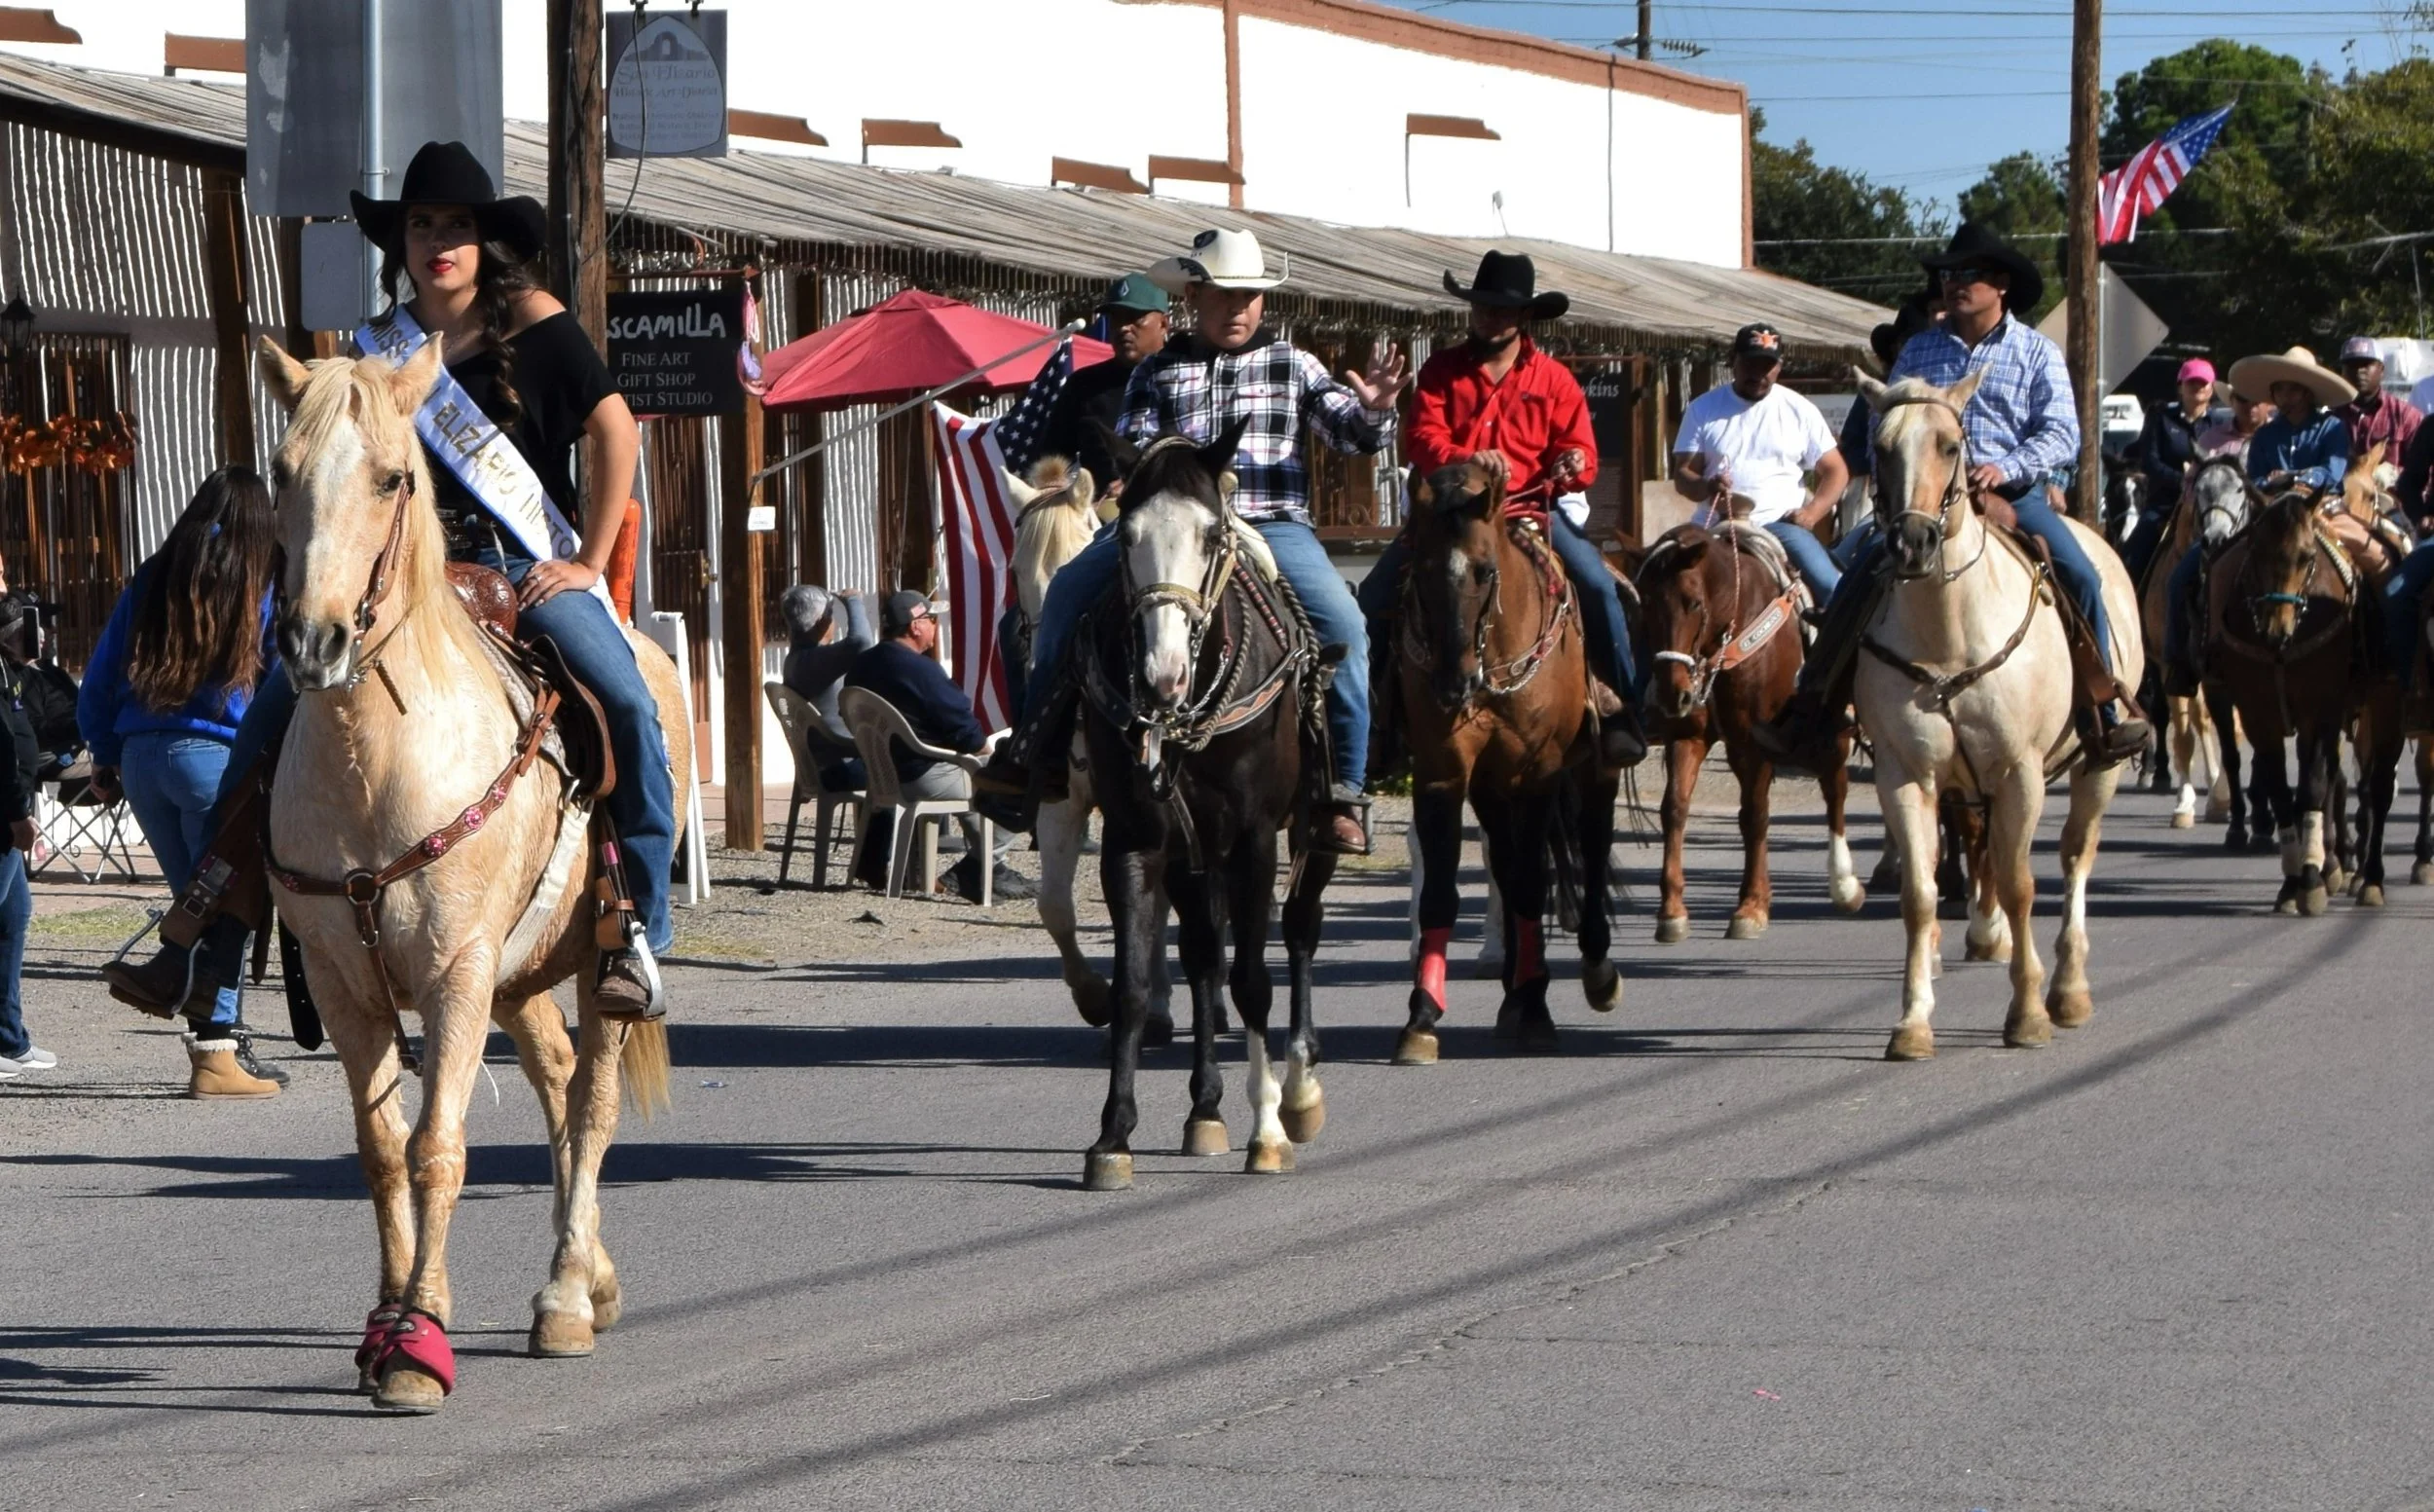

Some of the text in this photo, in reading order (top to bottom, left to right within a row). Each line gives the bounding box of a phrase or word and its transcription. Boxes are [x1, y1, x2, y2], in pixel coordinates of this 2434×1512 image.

[607, 303, 726, 340] SCAMILLA
[621, 351, 691, 367] FINE ART
[617, 372, 696, 387] GIFT SHOP
[624, 391, 713, 406] TIST STUDIO
